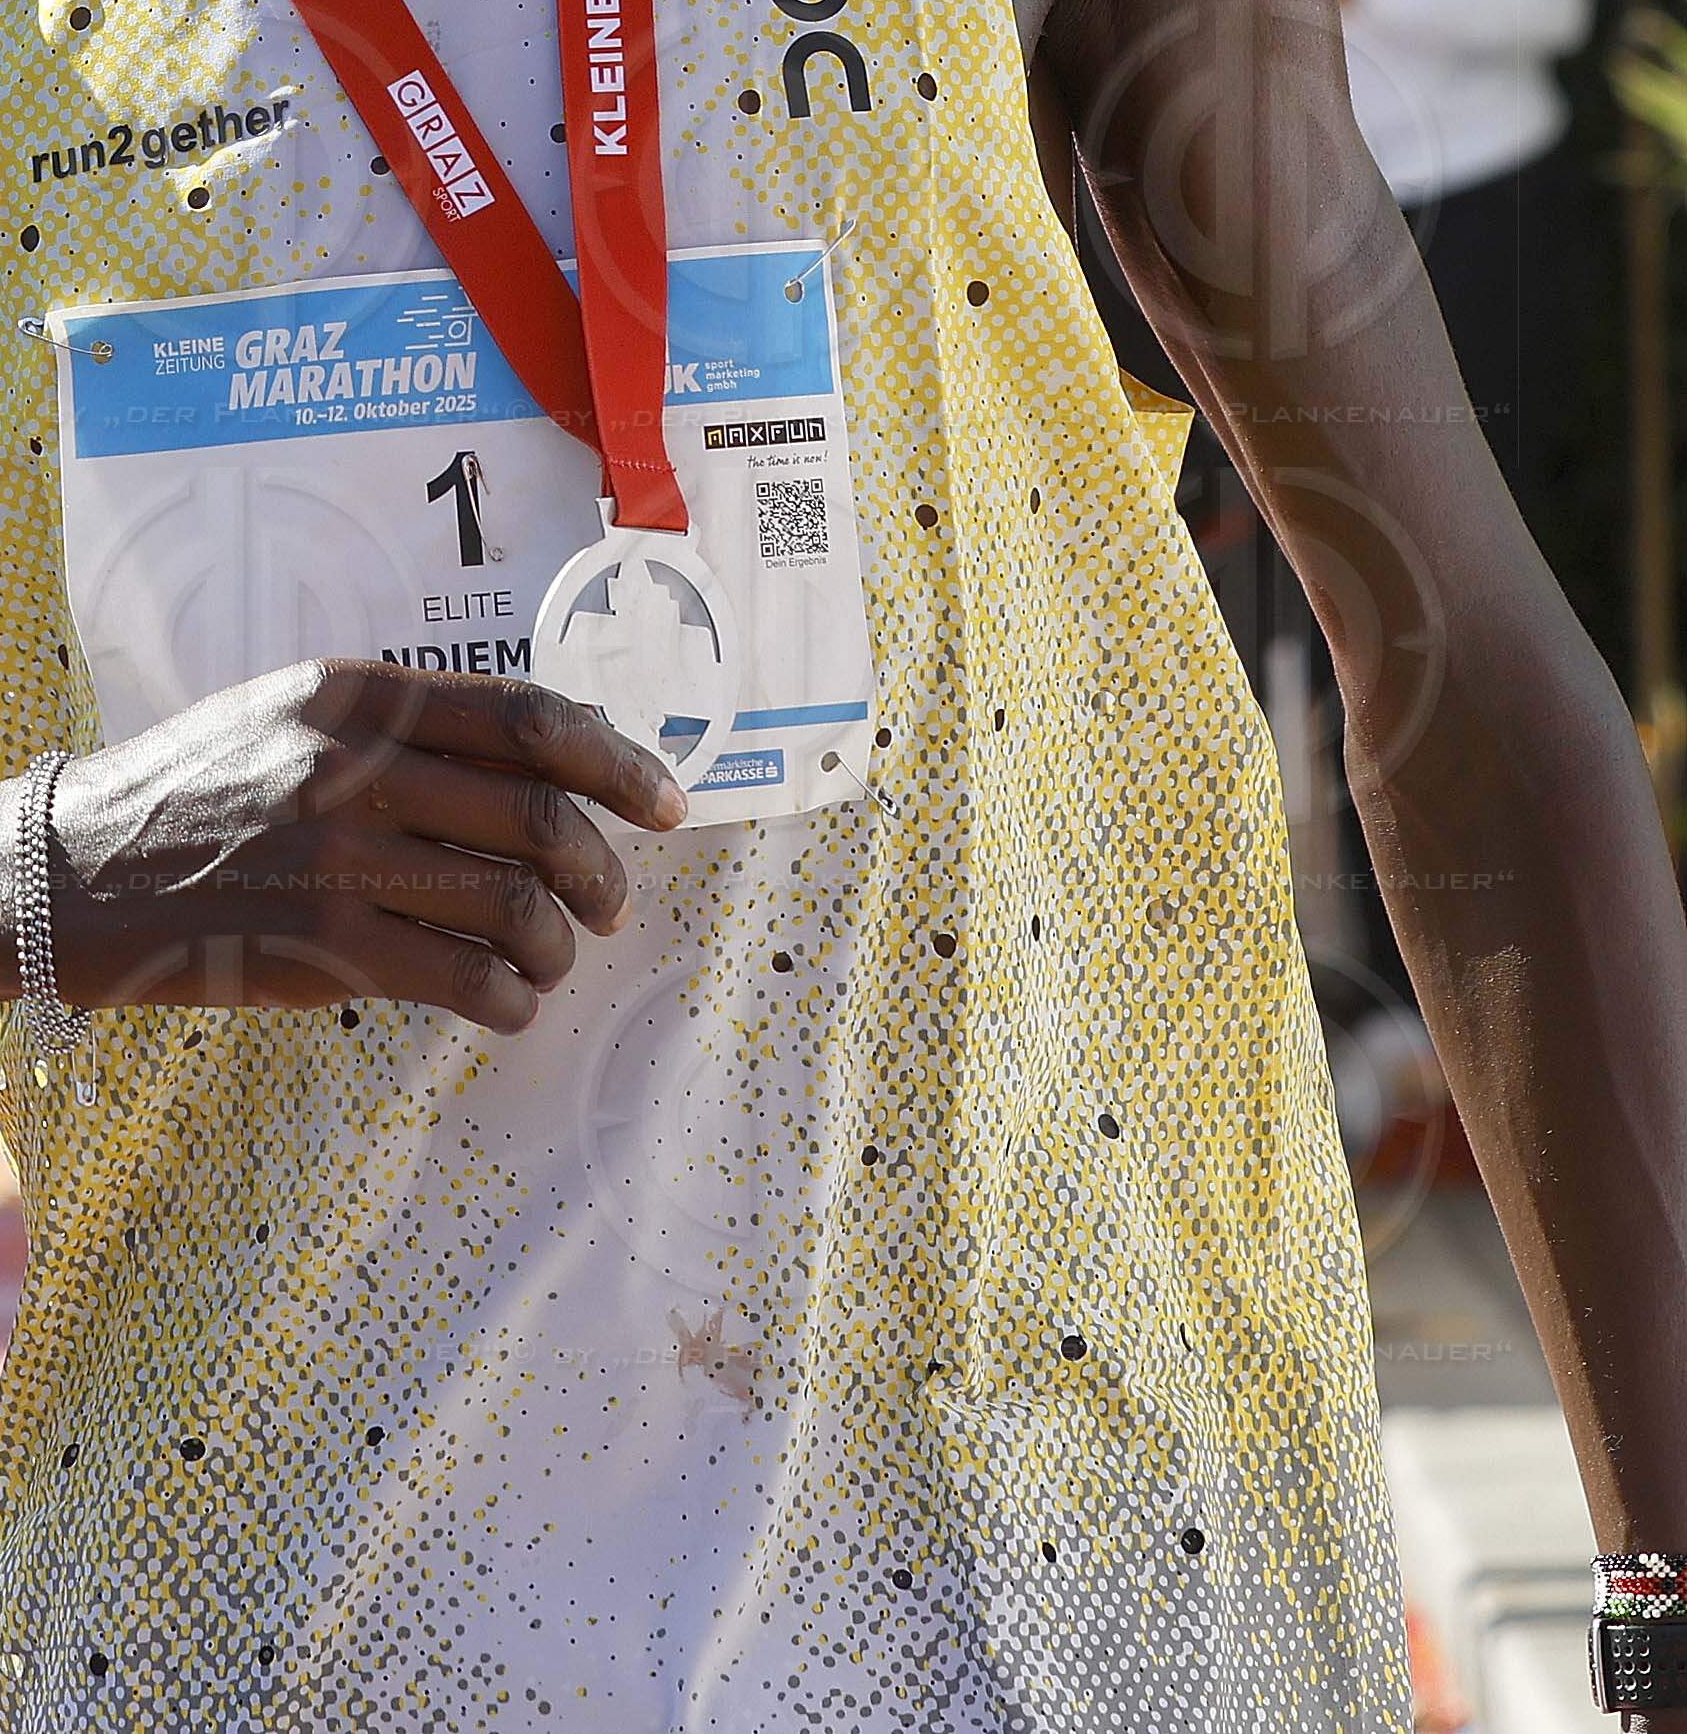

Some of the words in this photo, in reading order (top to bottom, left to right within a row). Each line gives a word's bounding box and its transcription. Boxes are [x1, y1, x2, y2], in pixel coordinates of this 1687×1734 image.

[31, 99, 290, 183] run2gether
[392, 75, 490, 213] GRAZ
[432, 187, 462, 223] SPORT
[153, 336, 224, 358] KLEINE
[235, 321, 348, 370] GRAZ
[155, 354, 225, 376] ZEITUNG
[704, 359, 734, 371] sport
[705, 367, 761, 380] marketing
[228, 351, 478, 411] MARATHON
[706, 380, 738, 393] gmbh
[353, 398, 431, 421] Oktober
[433, 393, 478, 414] 2025
[426, 449, 485, 567] 1
[423, 591, 514, 622] ELITE
[700, 766, 765, 785] PARKASSE
